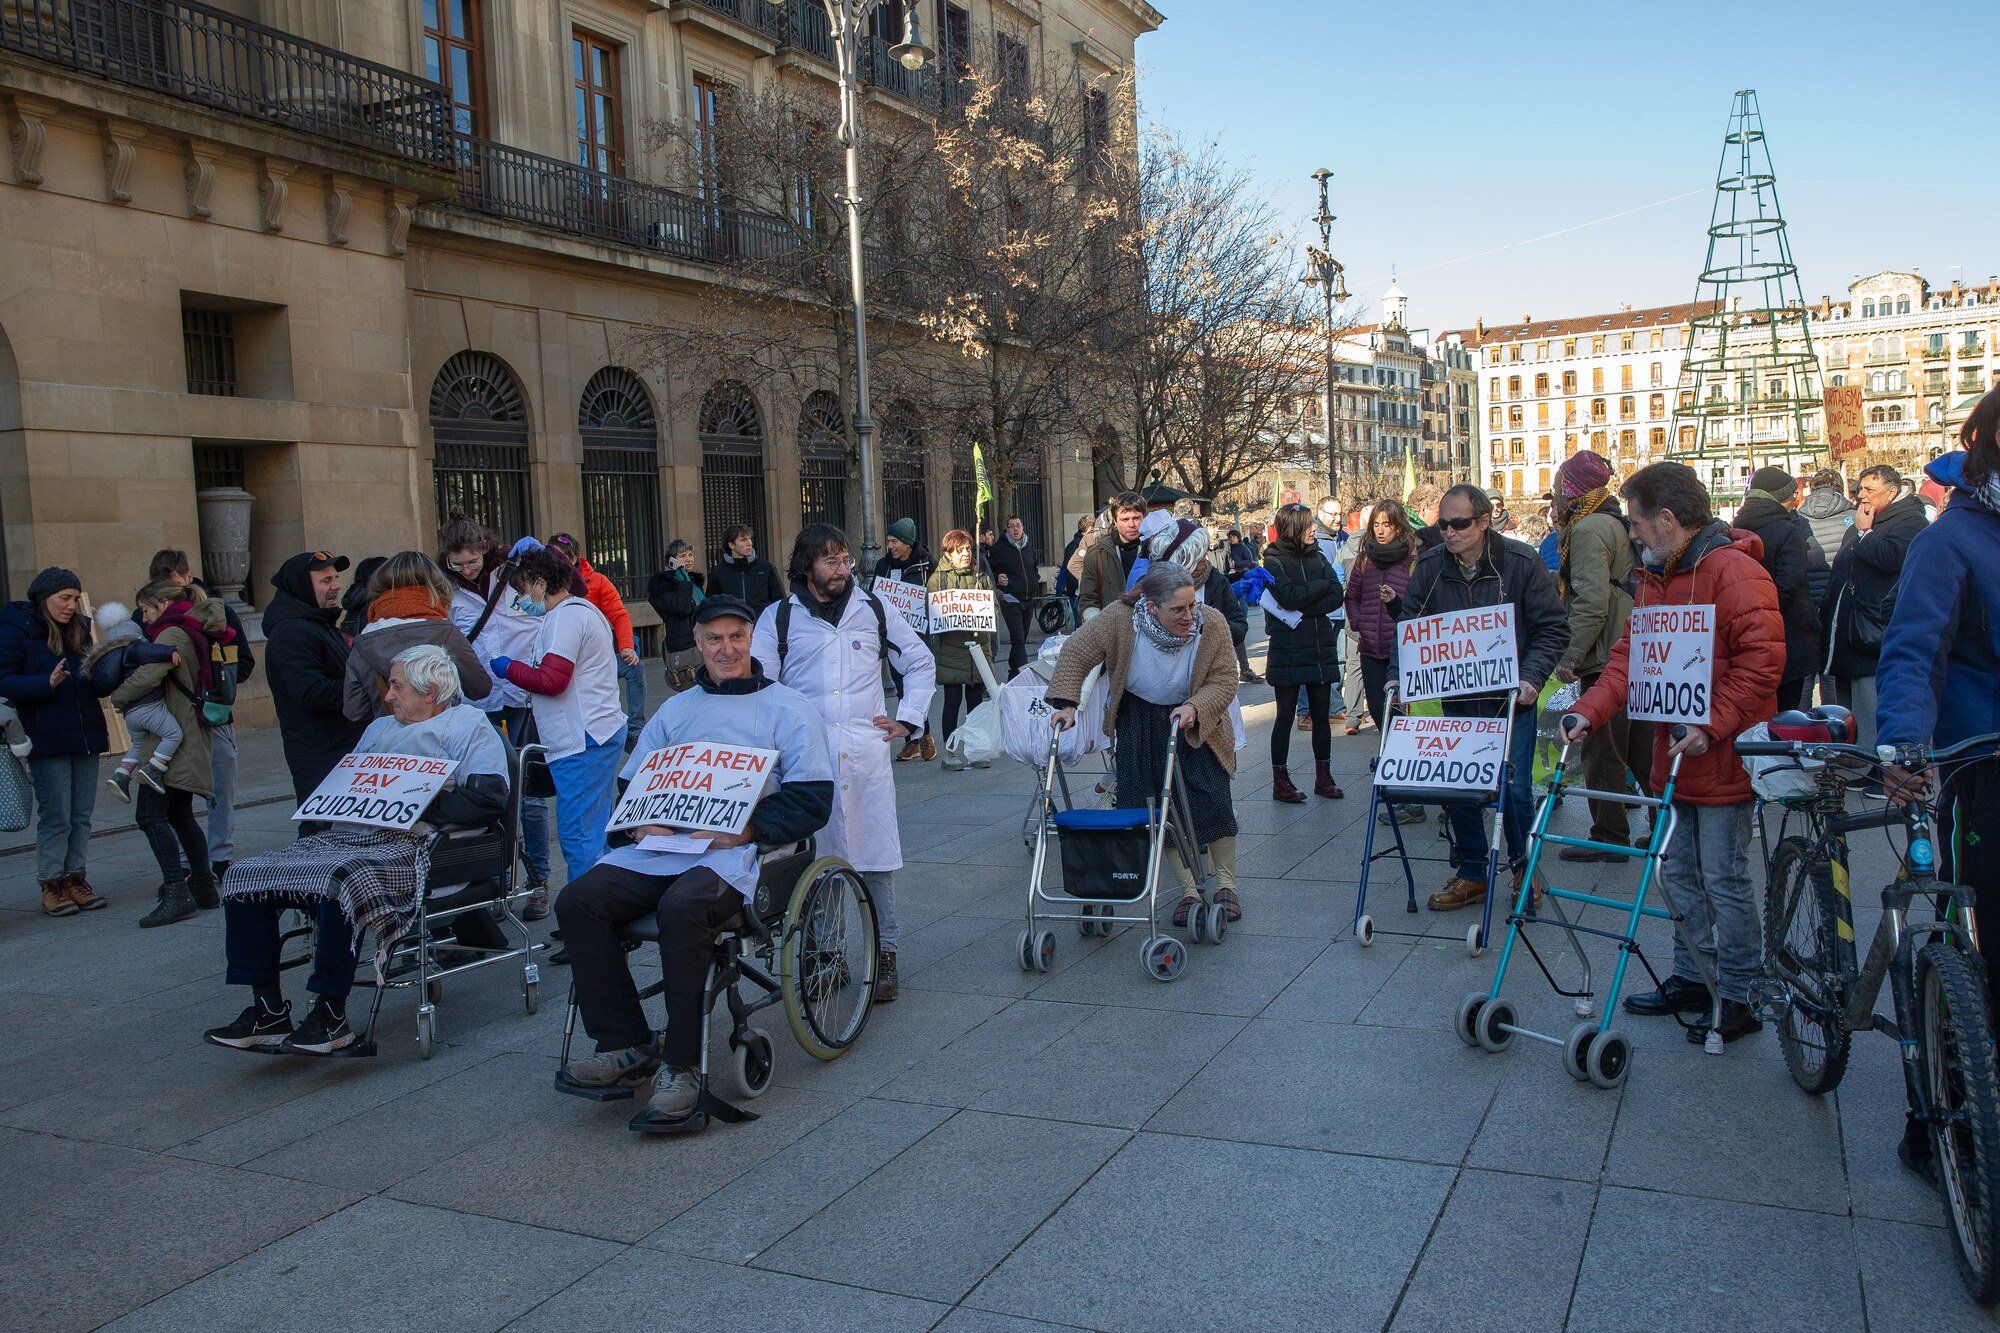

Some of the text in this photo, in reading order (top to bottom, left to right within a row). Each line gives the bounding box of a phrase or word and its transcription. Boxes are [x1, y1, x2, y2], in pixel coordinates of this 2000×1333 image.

[876, 579, 925, 600] AHT-ARE
[931, 591, 991, 605] AHT-AREN
[941, 603, 974, 615] DIRUA
[933, 615, 993, 631] ZAINTZARENTZAT
[1402, 611, 1508, 646] AHT-AREN
[1632, 610, 1710, 635] EL DINERO DEL
[1420, 638, 1477, 665] DIRUA
[1641, 641, 1673, 664] TAV
[1406, 657, 1513, 697] ZAINTZARENTZAT
[1643, 666, 1663, 676] PARA
[1628, 681, 1706, 717] CUIDADOS
[1393, 719, 1505, 734] EL DINERO DEL
[1415, 736, 1463, 751] TAV
[1418, 750, 1448, 758] PARA
[339, 756, 449, 776] EL DINERO DEL
[640, 744, 768, 773] AHT-AREN
[351, 772, 401, 788] TAV
[645, 770, 713, 792] DIRUA
[1381, 758, 1496, 785] CUIDADOS
[348, 787, 378, 795] PARA
[301, 795, 420, 824] CUIDADOS
[613, 793, 750, 829] ZAINTZARENTZAT
